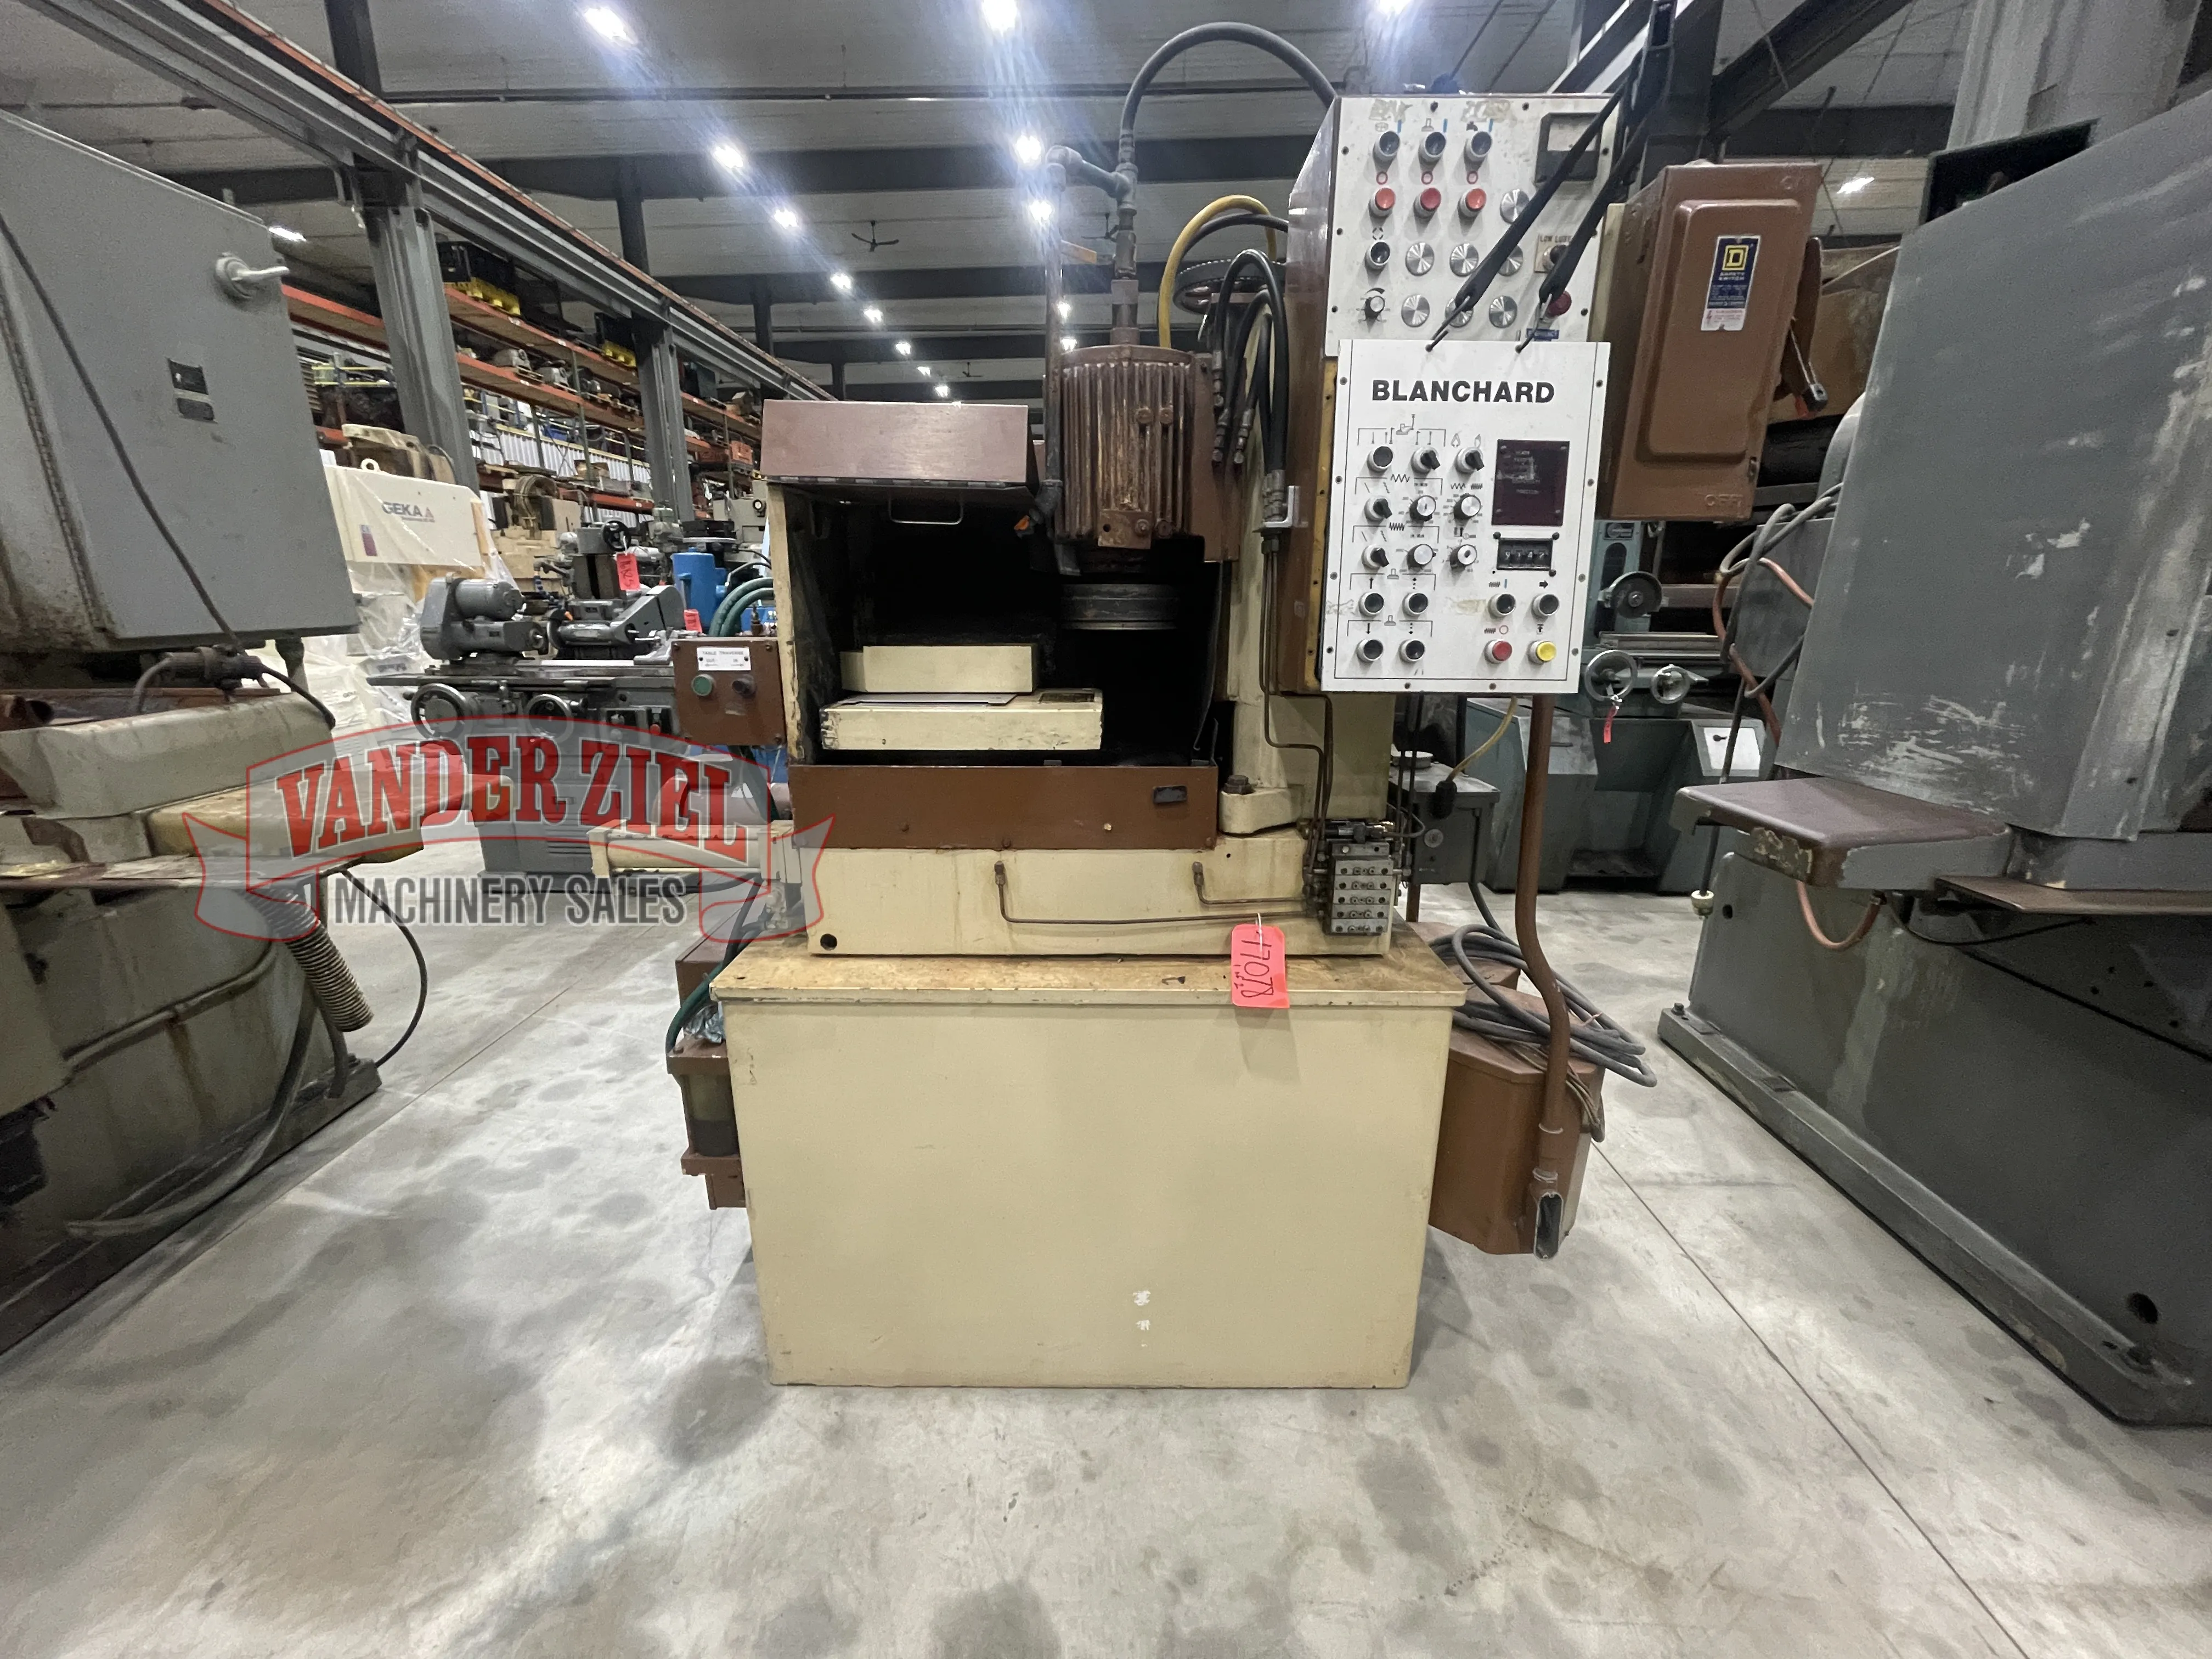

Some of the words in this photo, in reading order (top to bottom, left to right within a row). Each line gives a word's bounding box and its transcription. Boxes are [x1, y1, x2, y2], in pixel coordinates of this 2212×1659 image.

[1372, 380, 1555, 403] BLANCHARD
[381, 501, 422, 517] GEKA
[1240, 940, 1274, 997] 17078
